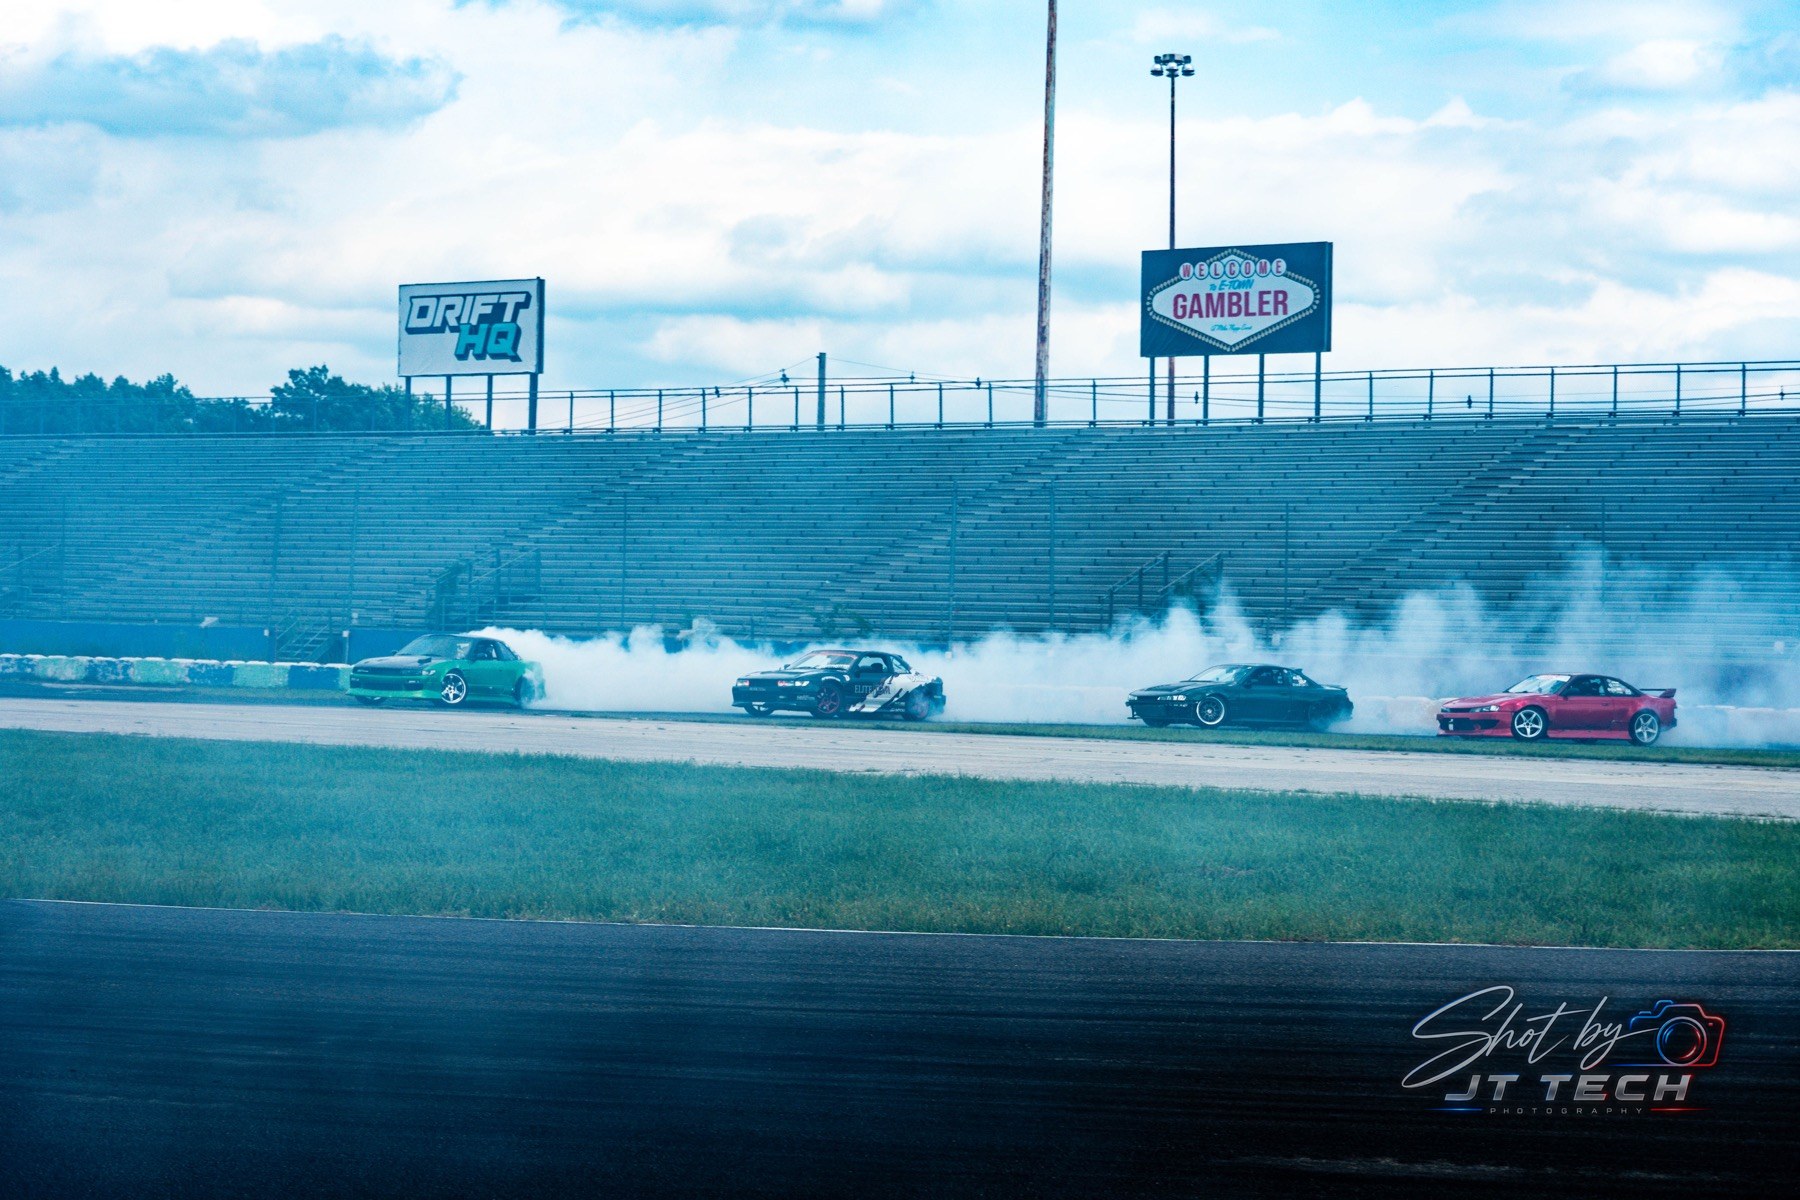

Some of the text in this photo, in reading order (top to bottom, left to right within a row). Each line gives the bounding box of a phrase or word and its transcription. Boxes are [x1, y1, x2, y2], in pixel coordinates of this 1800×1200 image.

[1181, 259, 1284, 279] WELCOME
[1218, 279, 1254, 291] E-TOWN
[406, 292, 531, 334] DRIFT
[1173, 290, 1288, 319] GAMBLER
[455, 323, 522, 361] HQ
